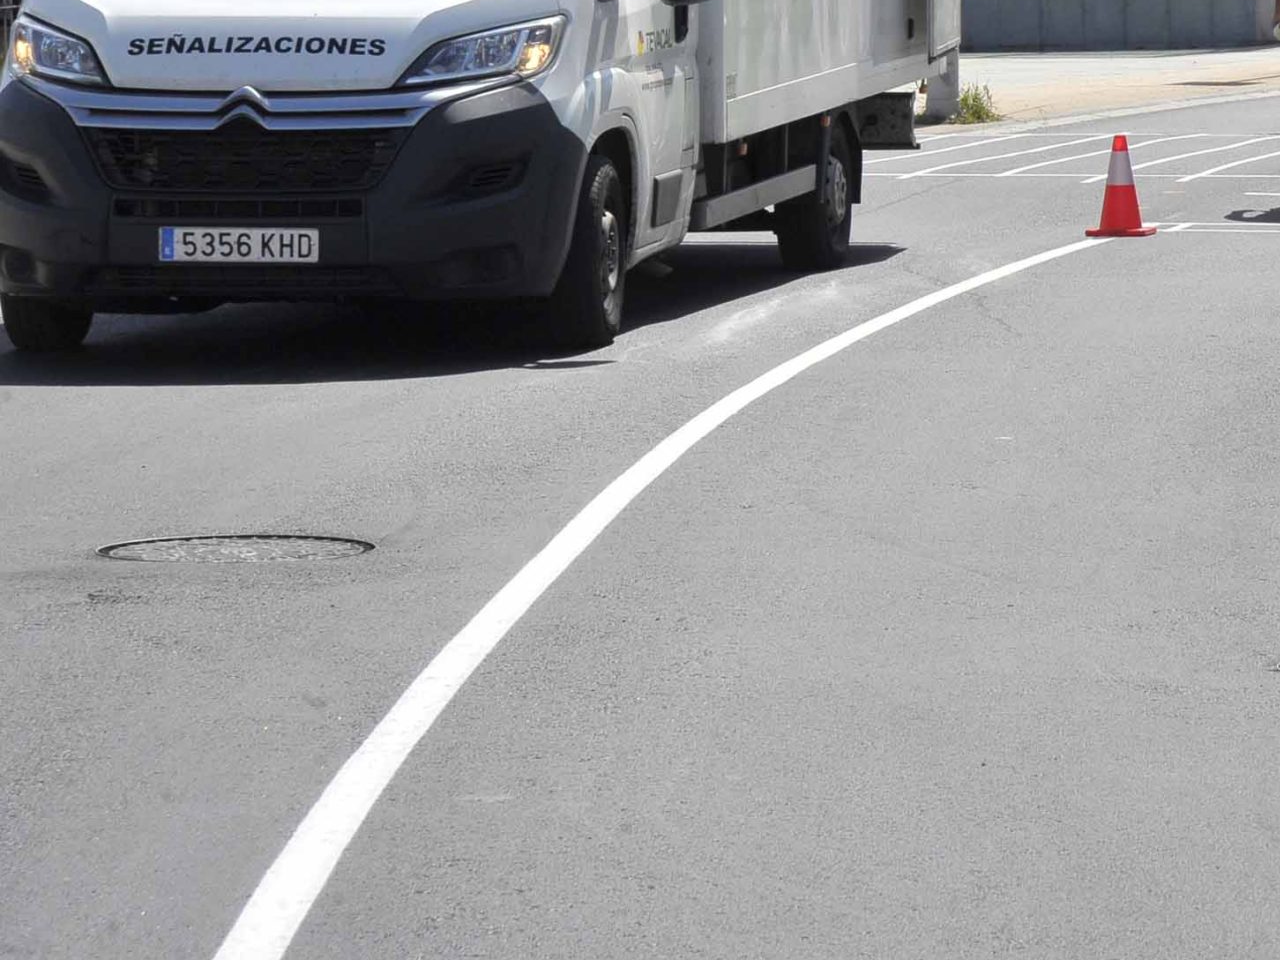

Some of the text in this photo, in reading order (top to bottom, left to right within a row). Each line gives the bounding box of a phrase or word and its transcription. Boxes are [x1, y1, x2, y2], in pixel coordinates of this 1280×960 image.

[127, 33, 386, 56] SEÑALIZACIONES
[182, 231, 312, 258] 5356 KHD
